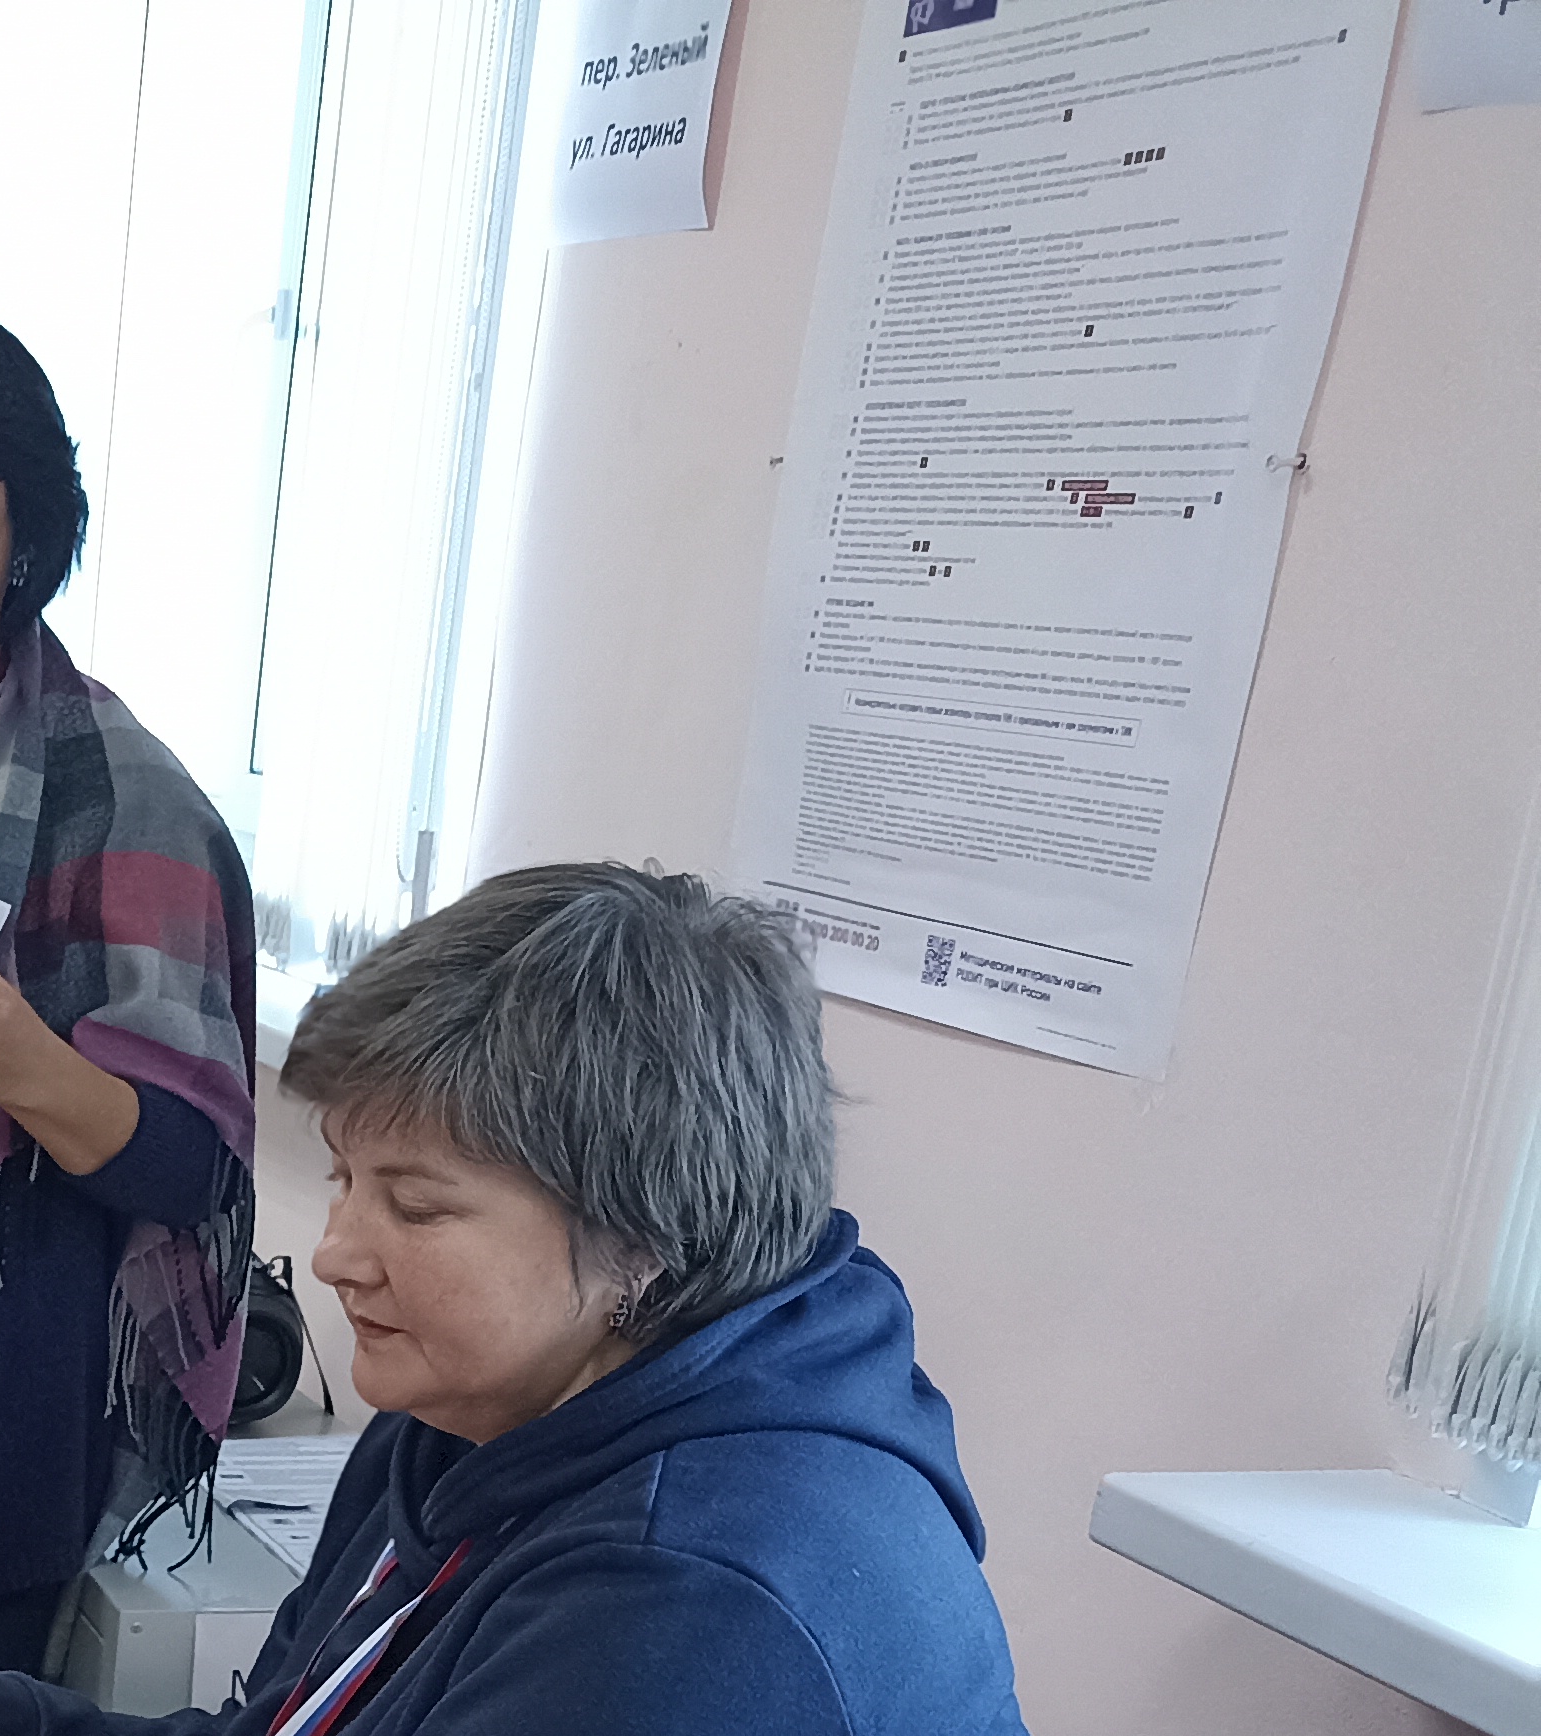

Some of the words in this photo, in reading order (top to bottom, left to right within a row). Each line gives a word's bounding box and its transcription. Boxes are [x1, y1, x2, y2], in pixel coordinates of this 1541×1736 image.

[580, 55, 620, 91] пер.
[625, 21, 710, 78] Зеленый
[569, 135, 595, 171] ул.
[600, 117, 688, 161] Гагарина
